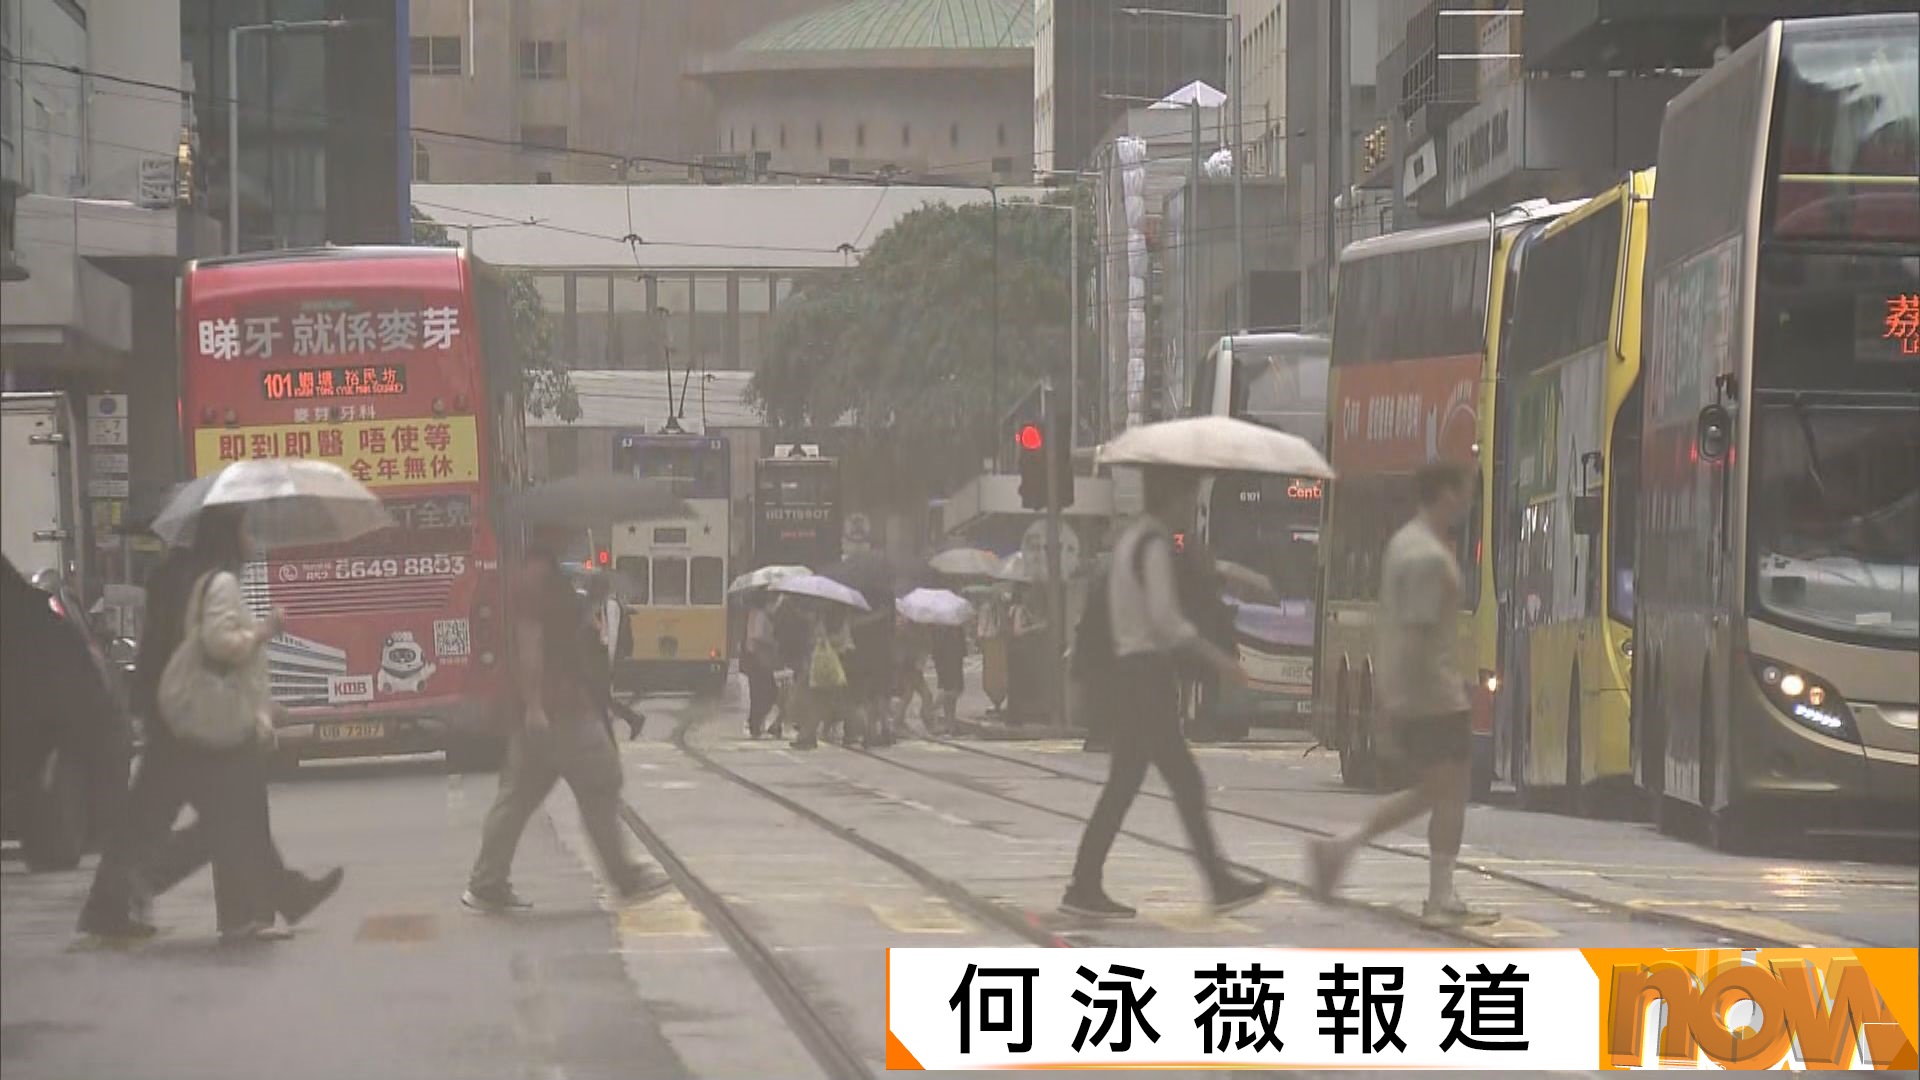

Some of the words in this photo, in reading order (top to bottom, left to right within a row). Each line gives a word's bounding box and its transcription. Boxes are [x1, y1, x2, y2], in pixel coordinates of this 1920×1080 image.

[198, 316, 283, 360] 睇牙
[291, 306, 461, 356] 就係麥芽
[264, 372, 292, 399] 101
[219, 429, 344, 461] 即到即醫
[359, 423, 451, 454] 唔使等
[351, 454, 453, 481] 全年無休
[334, 682, 367, 696] KMB
